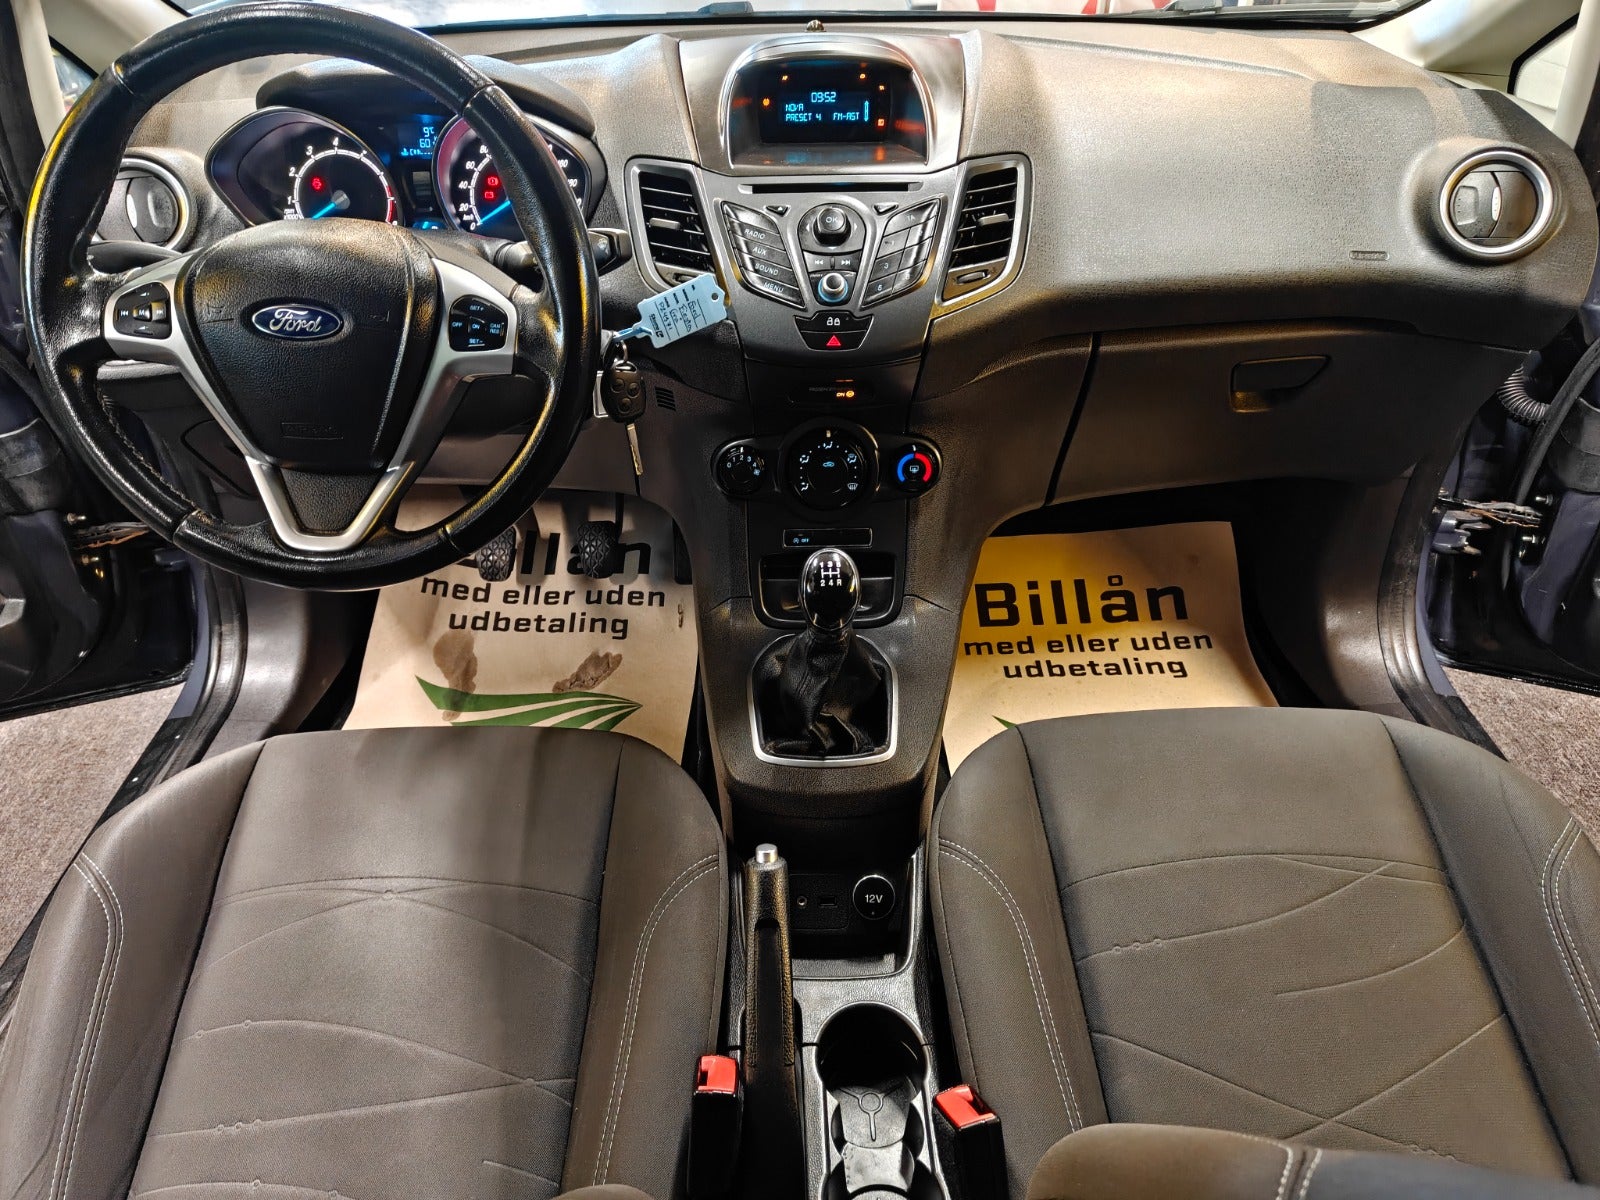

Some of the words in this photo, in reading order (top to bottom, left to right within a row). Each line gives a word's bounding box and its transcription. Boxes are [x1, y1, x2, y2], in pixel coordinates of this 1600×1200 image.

[785, 112, 812, 121] PRESET
[815, 113, 822, 121] 4
[833, 112, 860, 120] FM-AST
[333, 137, 338, 146] 4
[306, 146, 313, 155] 3
[466, 161, 475, 169] 60
[289, 167, 296, 177] 2
[459, 181, 468, 189] 40
[287, 196, 292, 205] 1
[459, 203, 469, 211] 20
[470, 222, 476, 230] 0
[744, 228, 765, 239] RADIO
[753, 246, 767, 256] AUX
[755, 263, 779, 276] SOUND
[764, 282, 784, 293] MENU
[269, 308, 322, 332] Ford
[421, 577, 491, 603] med
[502, 585, 575, 605] eller
[585, 585, 665, 607] uden
[974, 575, 1188, 627] Billån
[449, 610, 629, 640] udbetaling
[964, 636, 1035, 655] med
[1047, 634, 1120, 653] eller
[1130, 631, 1213, 651] uden
[1003, 657, 1188, 678] udbetaling
[865, 894, 883, 903] 12V
